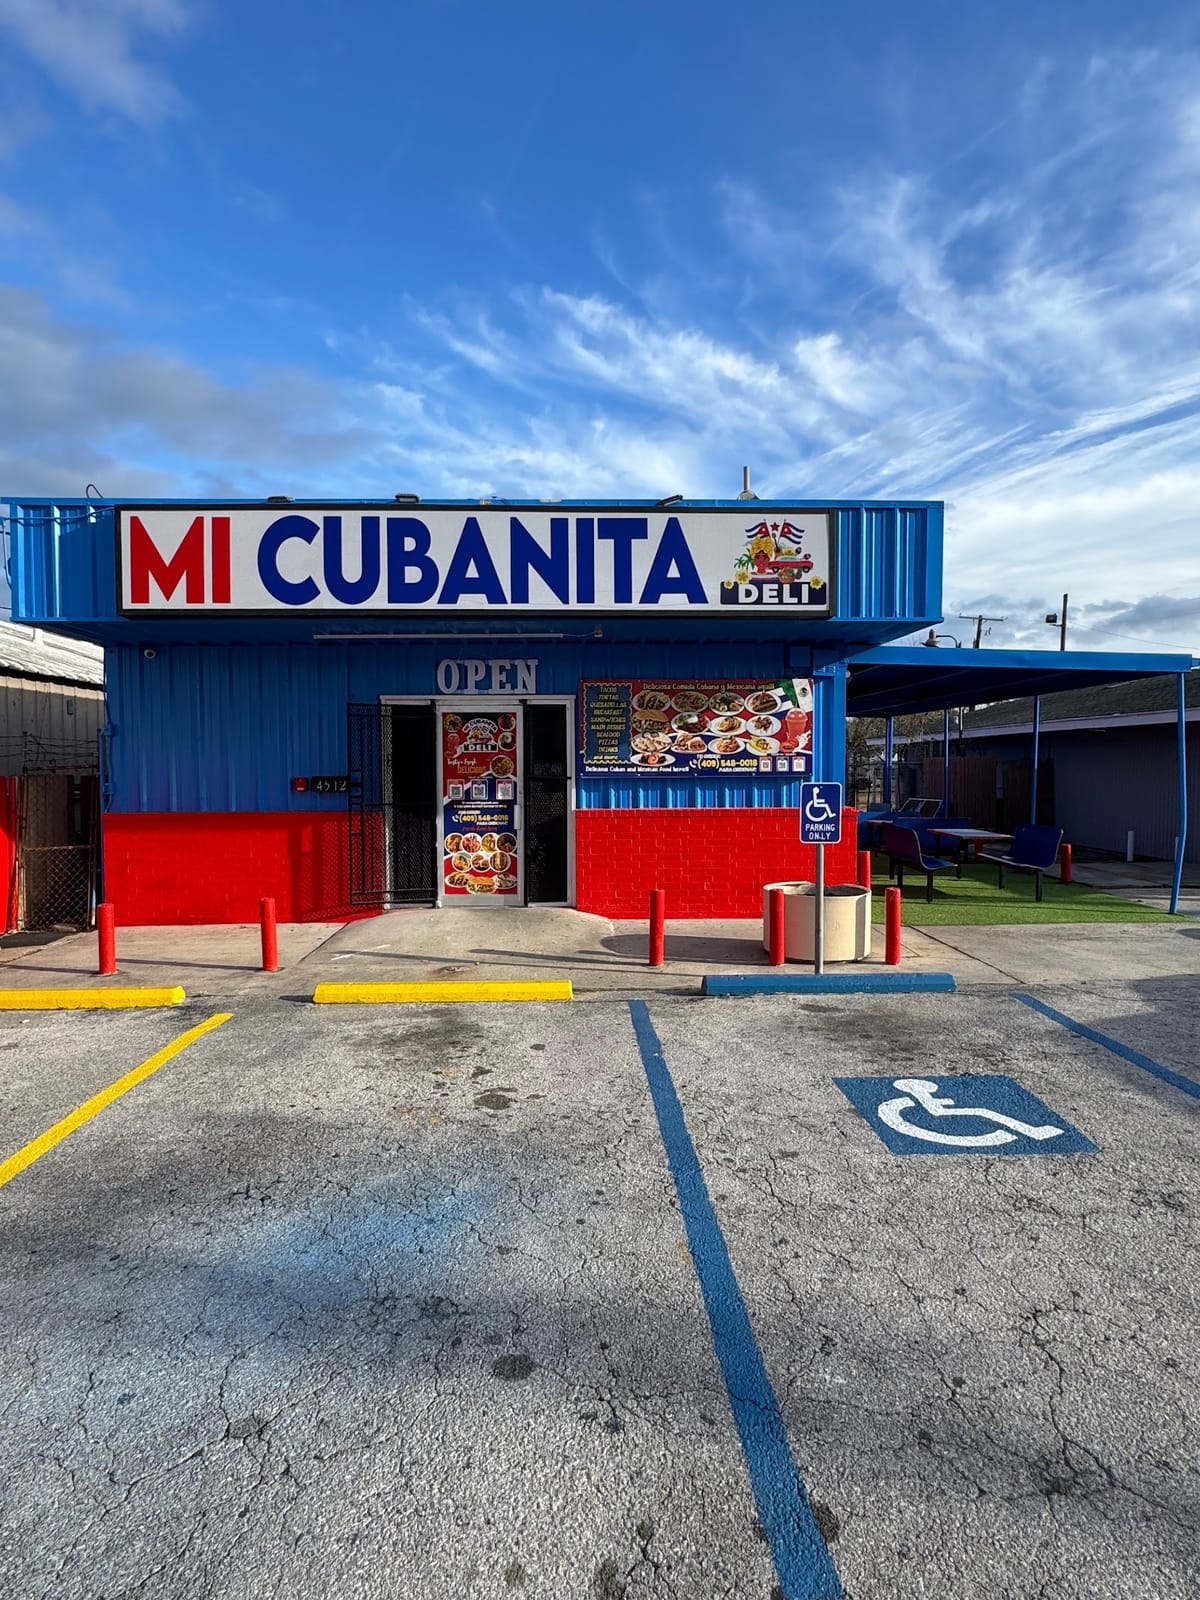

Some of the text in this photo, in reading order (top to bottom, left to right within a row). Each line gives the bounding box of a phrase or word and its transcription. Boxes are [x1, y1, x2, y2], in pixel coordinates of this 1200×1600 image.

[130, 515, 709, 606] MI CUBANITA
[738, 583, 809, 604] DELI
[437, 659, 538, 694] OPEN
[698, 758, 758, 769] (409) 548-0018
[316, 780, 347, 791] 4512
[805, 824, 836, 832] PARKING
[808, 832, 832, 840] ONLY
